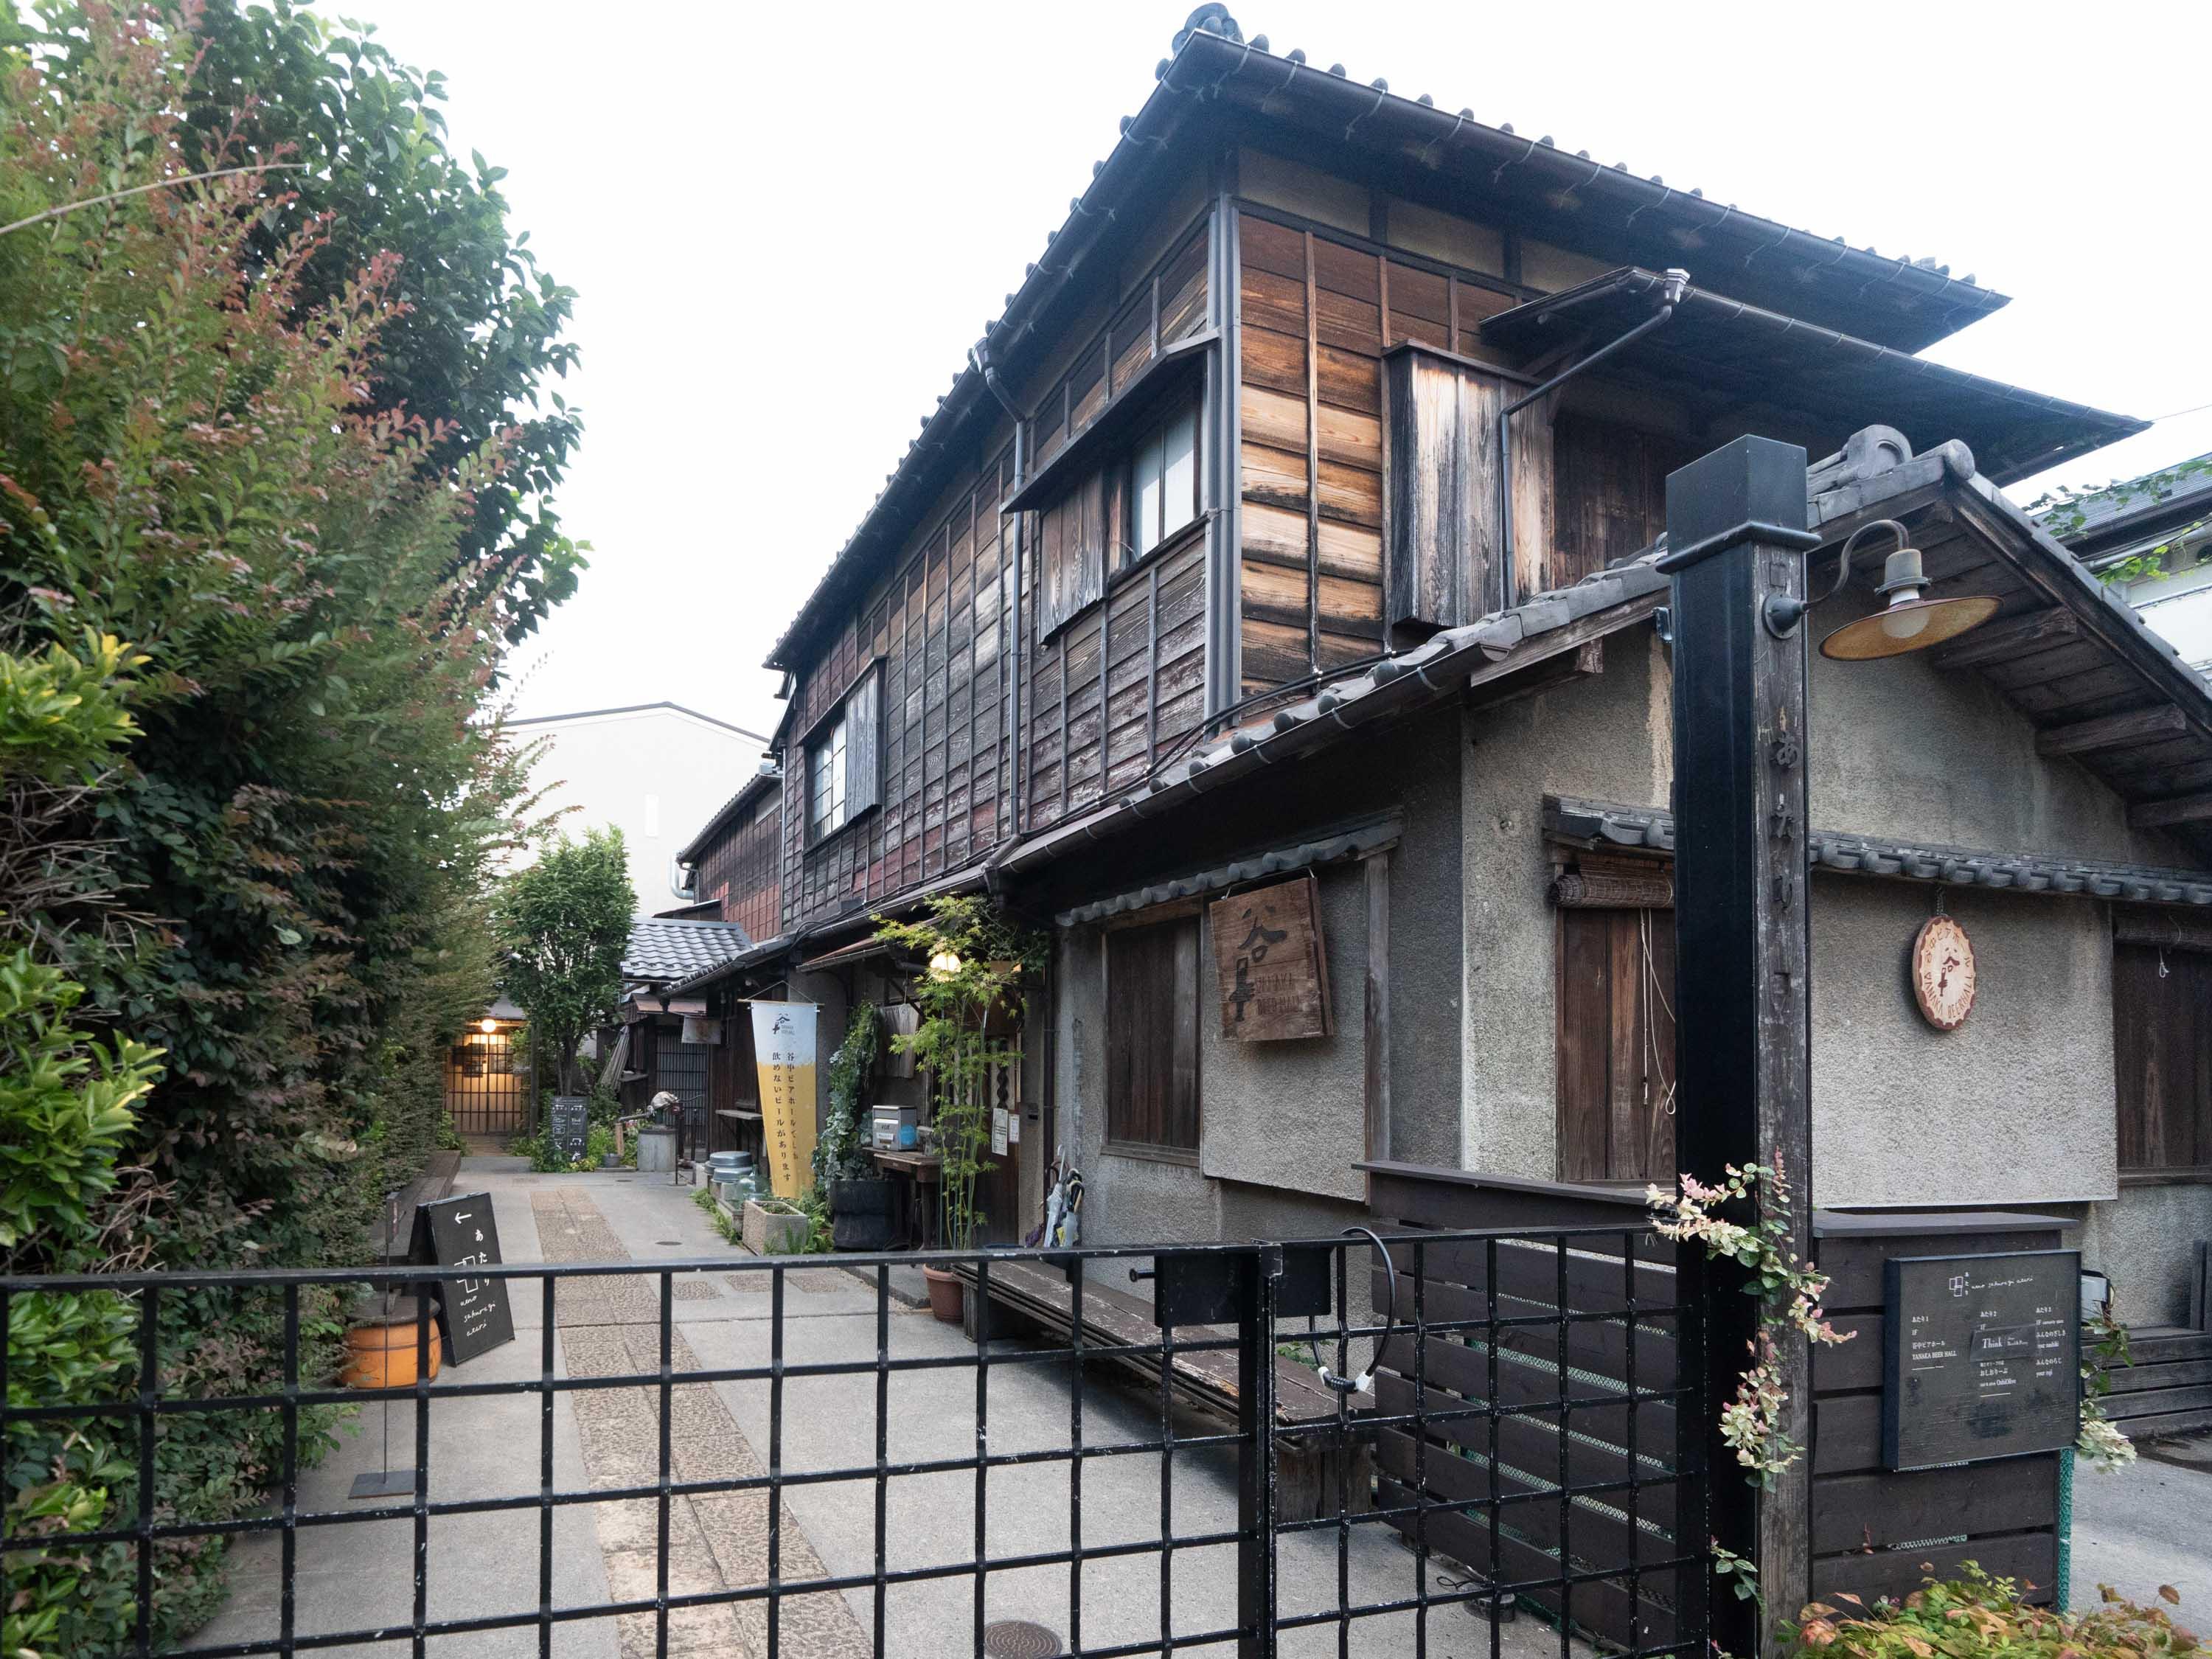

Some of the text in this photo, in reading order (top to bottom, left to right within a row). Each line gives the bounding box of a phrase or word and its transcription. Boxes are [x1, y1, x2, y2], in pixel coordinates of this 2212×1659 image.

[1771, 731, 1799, 912] あたり
[772, 1051, 791, 1181] 飲めないビールがあります
[459, 1295, 478, 1307] ueno
[463, 1300, 496, 1324] sakuragi
[466, 1318, 487, 1337] atari
[1982, 1337, 2003, 1349] Think
[1912, 1352, 1931, 1360] YANAKA
